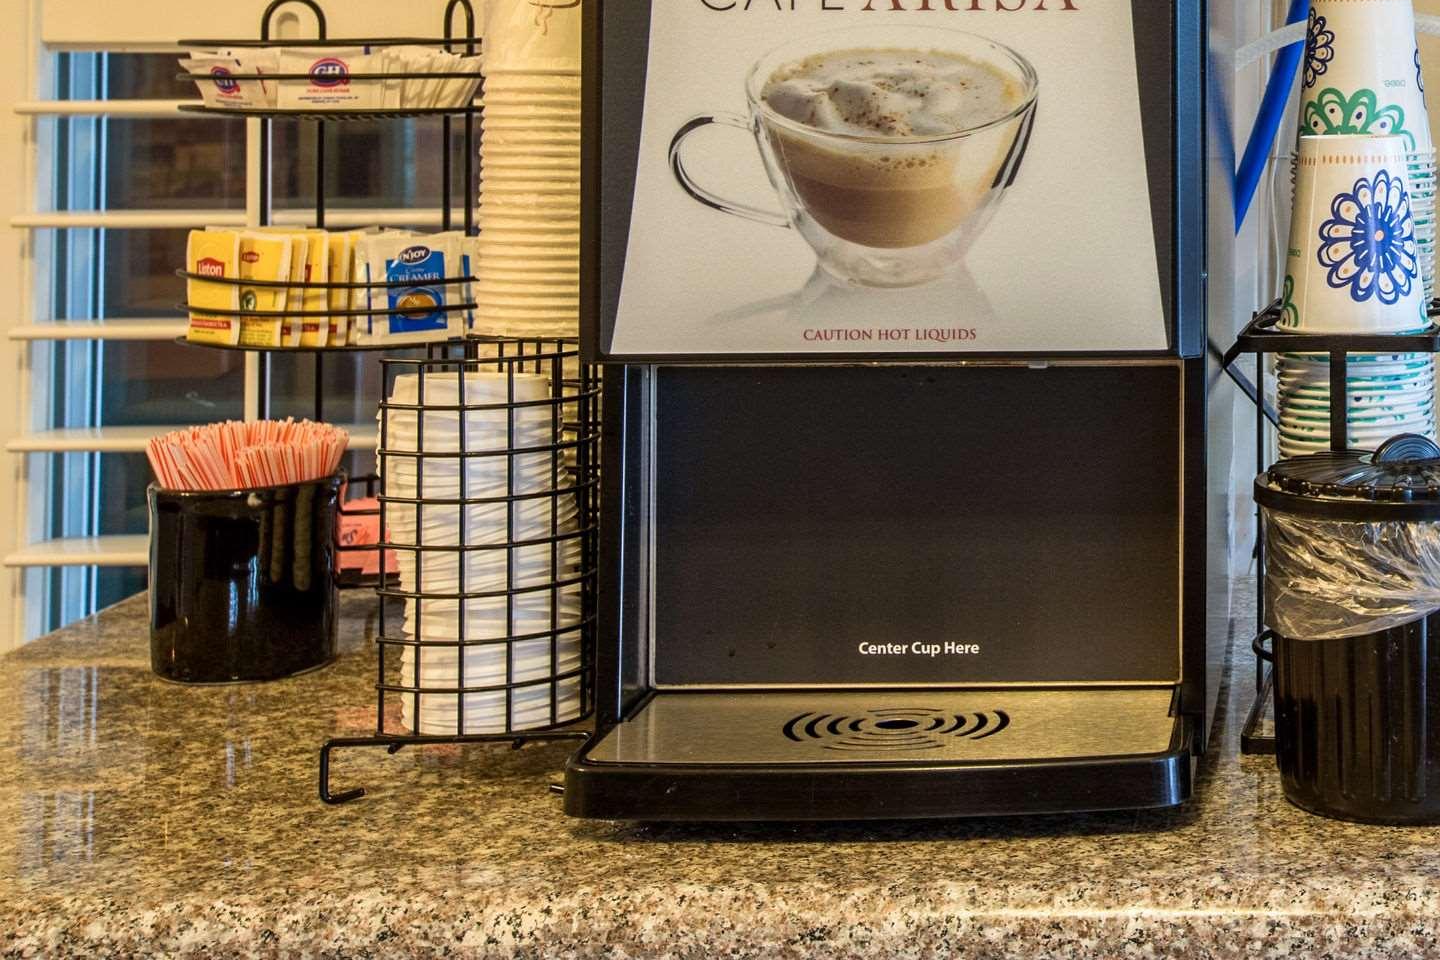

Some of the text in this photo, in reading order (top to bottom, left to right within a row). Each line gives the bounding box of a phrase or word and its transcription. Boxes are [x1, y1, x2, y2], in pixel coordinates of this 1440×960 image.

[803, 328, 977, 342] CAUTION HOT LIQUIDS
[859, 642, 980, 658] Center Cup Here
